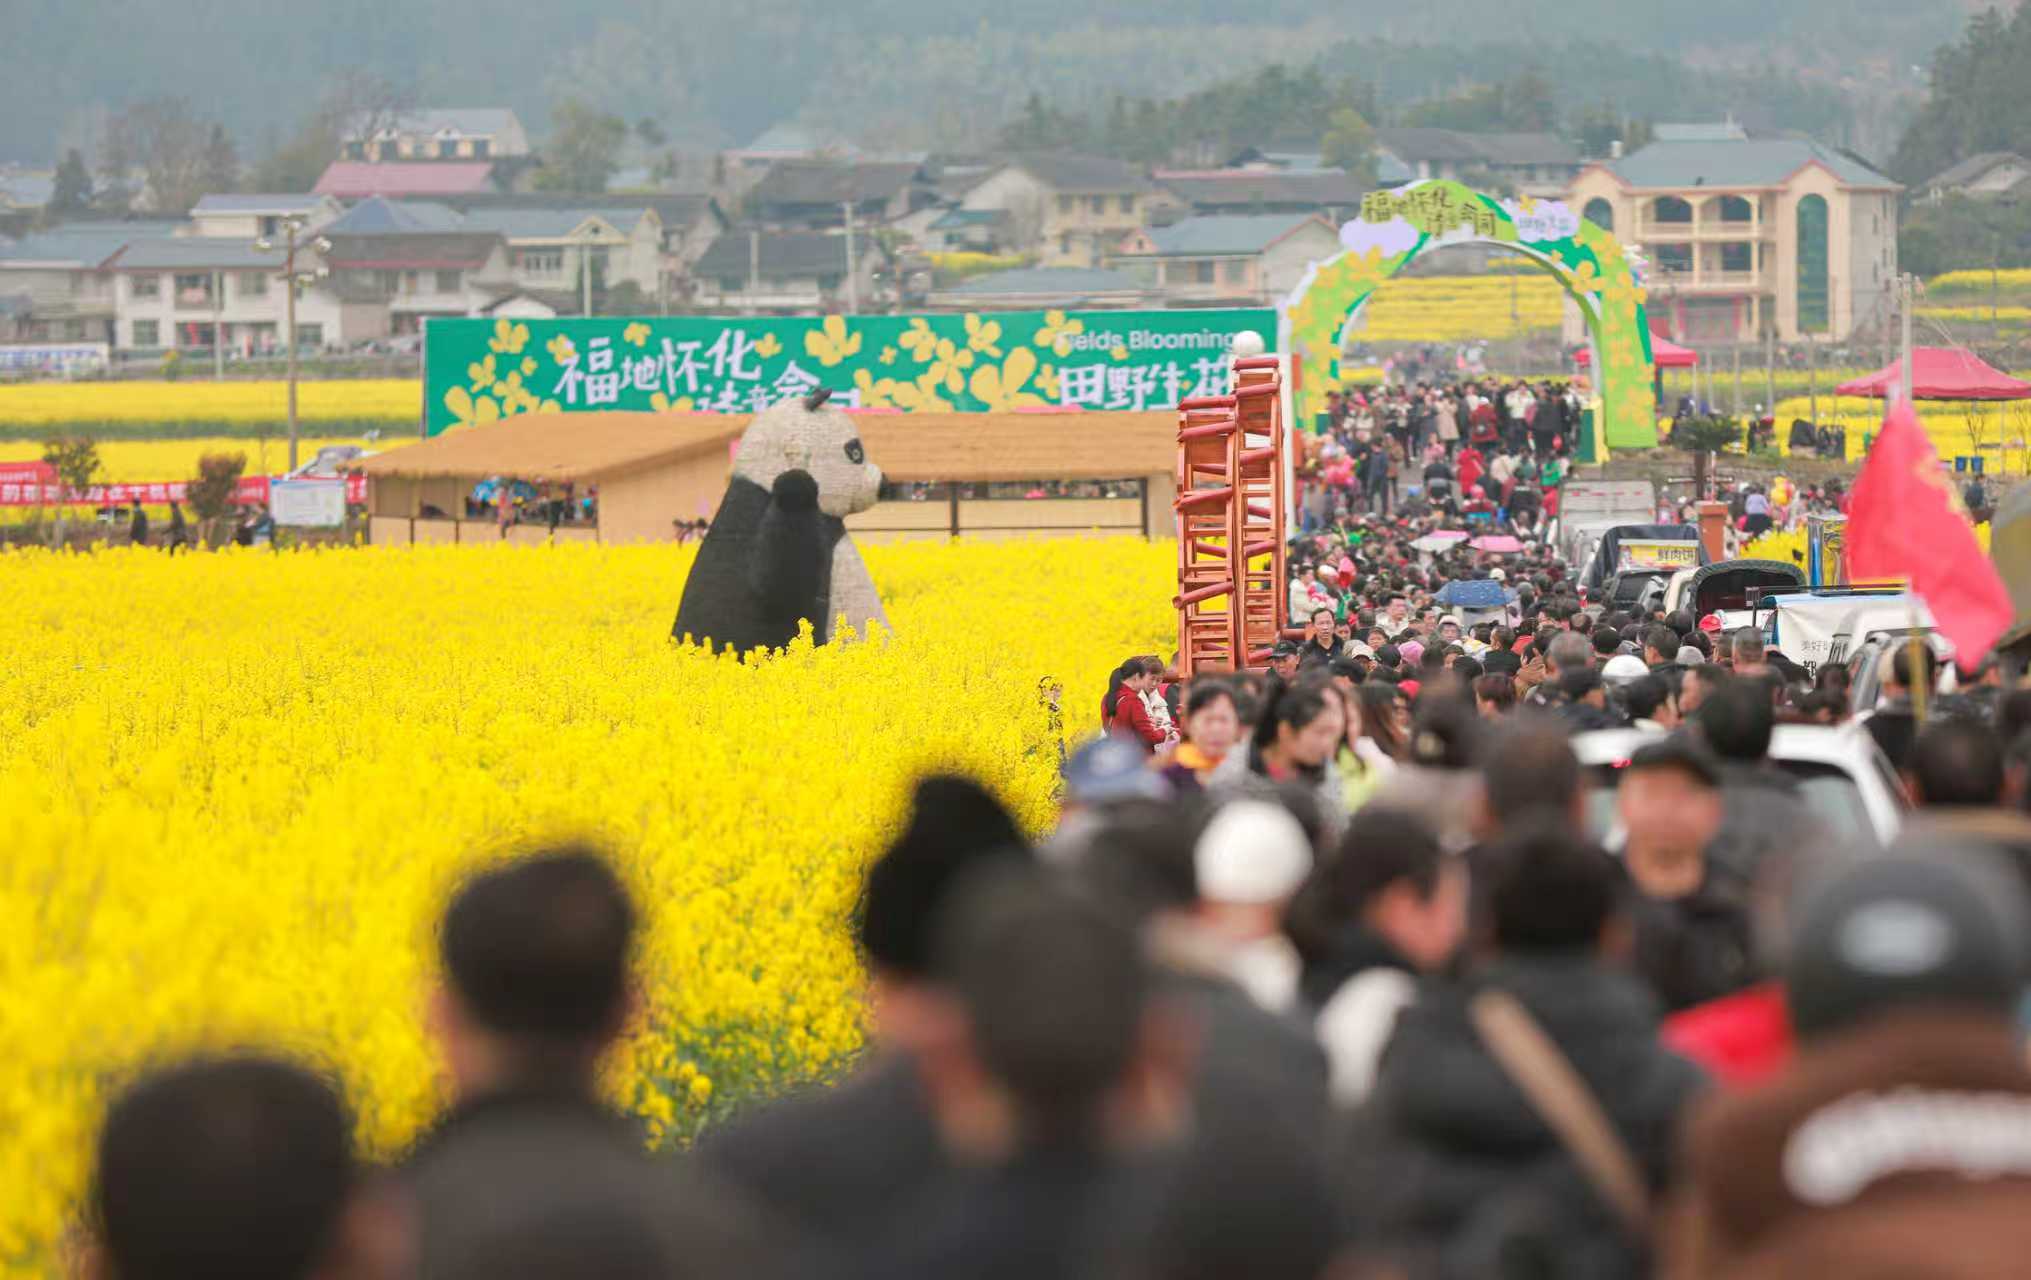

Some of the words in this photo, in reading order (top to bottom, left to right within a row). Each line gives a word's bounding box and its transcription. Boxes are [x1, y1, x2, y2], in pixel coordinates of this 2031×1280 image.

[1129, 328, 1234, 353] Blooming
[553, 328, 762, 404] 福地怀化
